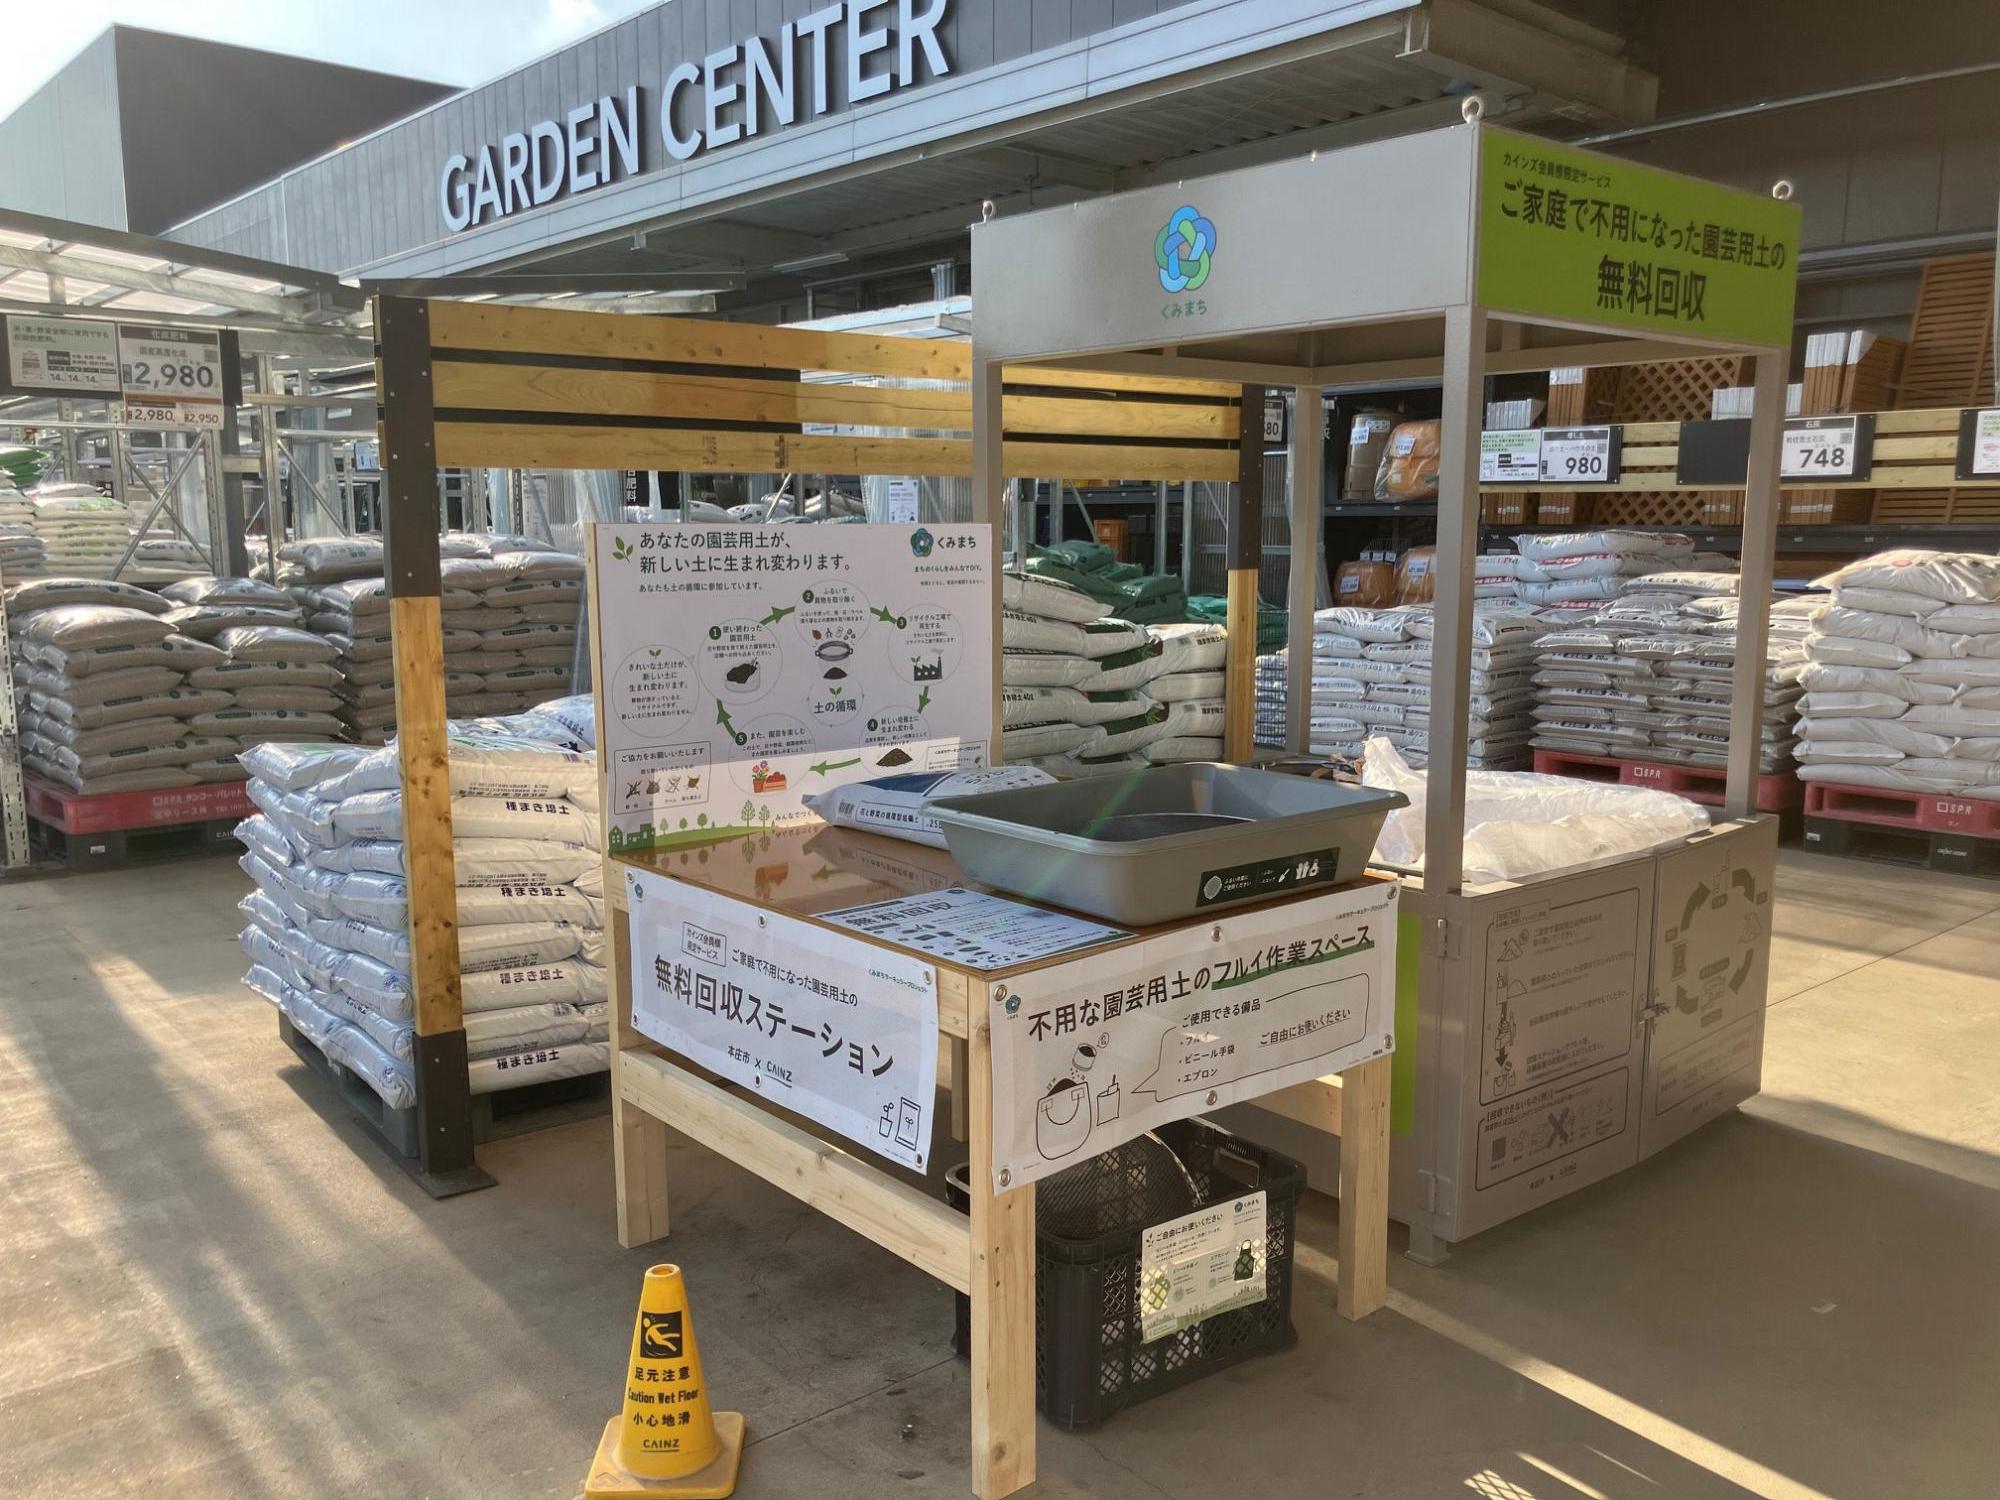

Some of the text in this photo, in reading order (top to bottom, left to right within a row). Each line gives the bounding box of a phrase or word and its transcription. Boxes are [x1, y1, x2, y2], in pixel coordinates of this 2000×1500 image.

[440, 0, 949, 232] GARDEN CENTER
[1503, 151, 1611, 189] カインズ会員様限定サービス
[1500, 180, 1786, 270] ご家庭で不用になった園芸用土の
[1596, 254, 1707, 322] 無料回収
[1161, 299, 1208, 319] くみまち
[134, 361, 214, 389] 2,980
[134, 408, 173, 423] 2,980
[1566, 456, 1602, 475] 980
[1800, 447, 1845, 469] 748
[639, 531, 792, 550] あなたの園芸用土が、
[937, 535, 977, 549] くみまち
[639, 553, 850, 574] 新しい土に生まれ変わります。
[639, 582, 763, 593] あなたも土の循環に参加しています。
[629, 660, 688, 671] きれいな土だけが、
[643, 671, 678, 680] 新しい土に
[629, 682, 689, 693] 生まれ変わります。
[813, 699, 857, 714] 土の循環
[621, 747, 705, 763] ご協力をお願いいたします
[1950, 802, 1972, 815] SPR
[845, 900, 956, 927] 無料回収
[731, 948, 858, 1007] ご家庭で不用になった園芸用土の
[1028, 925, 1372, 1043] 不用な園芸用土のフルイ作業スペース
[654, 954, 894, 1078] 無料回収ステーション
[1181, 998, 1262, 1029] ご使用できる備品
[1260, 1007, 1351, 1046] ご自由にお使いください
[727, 1045, 751, 1065] 本庄市
[766, 1060, 793, 1083] CAINZ
[1156, 1213, 1224, 1242] ご自由にお使いください
[634, 1366, 691, 1382] 足元注意
[628, 1386, 699, 1405] Caution Wet Floor
[633, 1412, 691, 1428] 小心地滑
[643, 1438, 680, 1449] CAINZ
